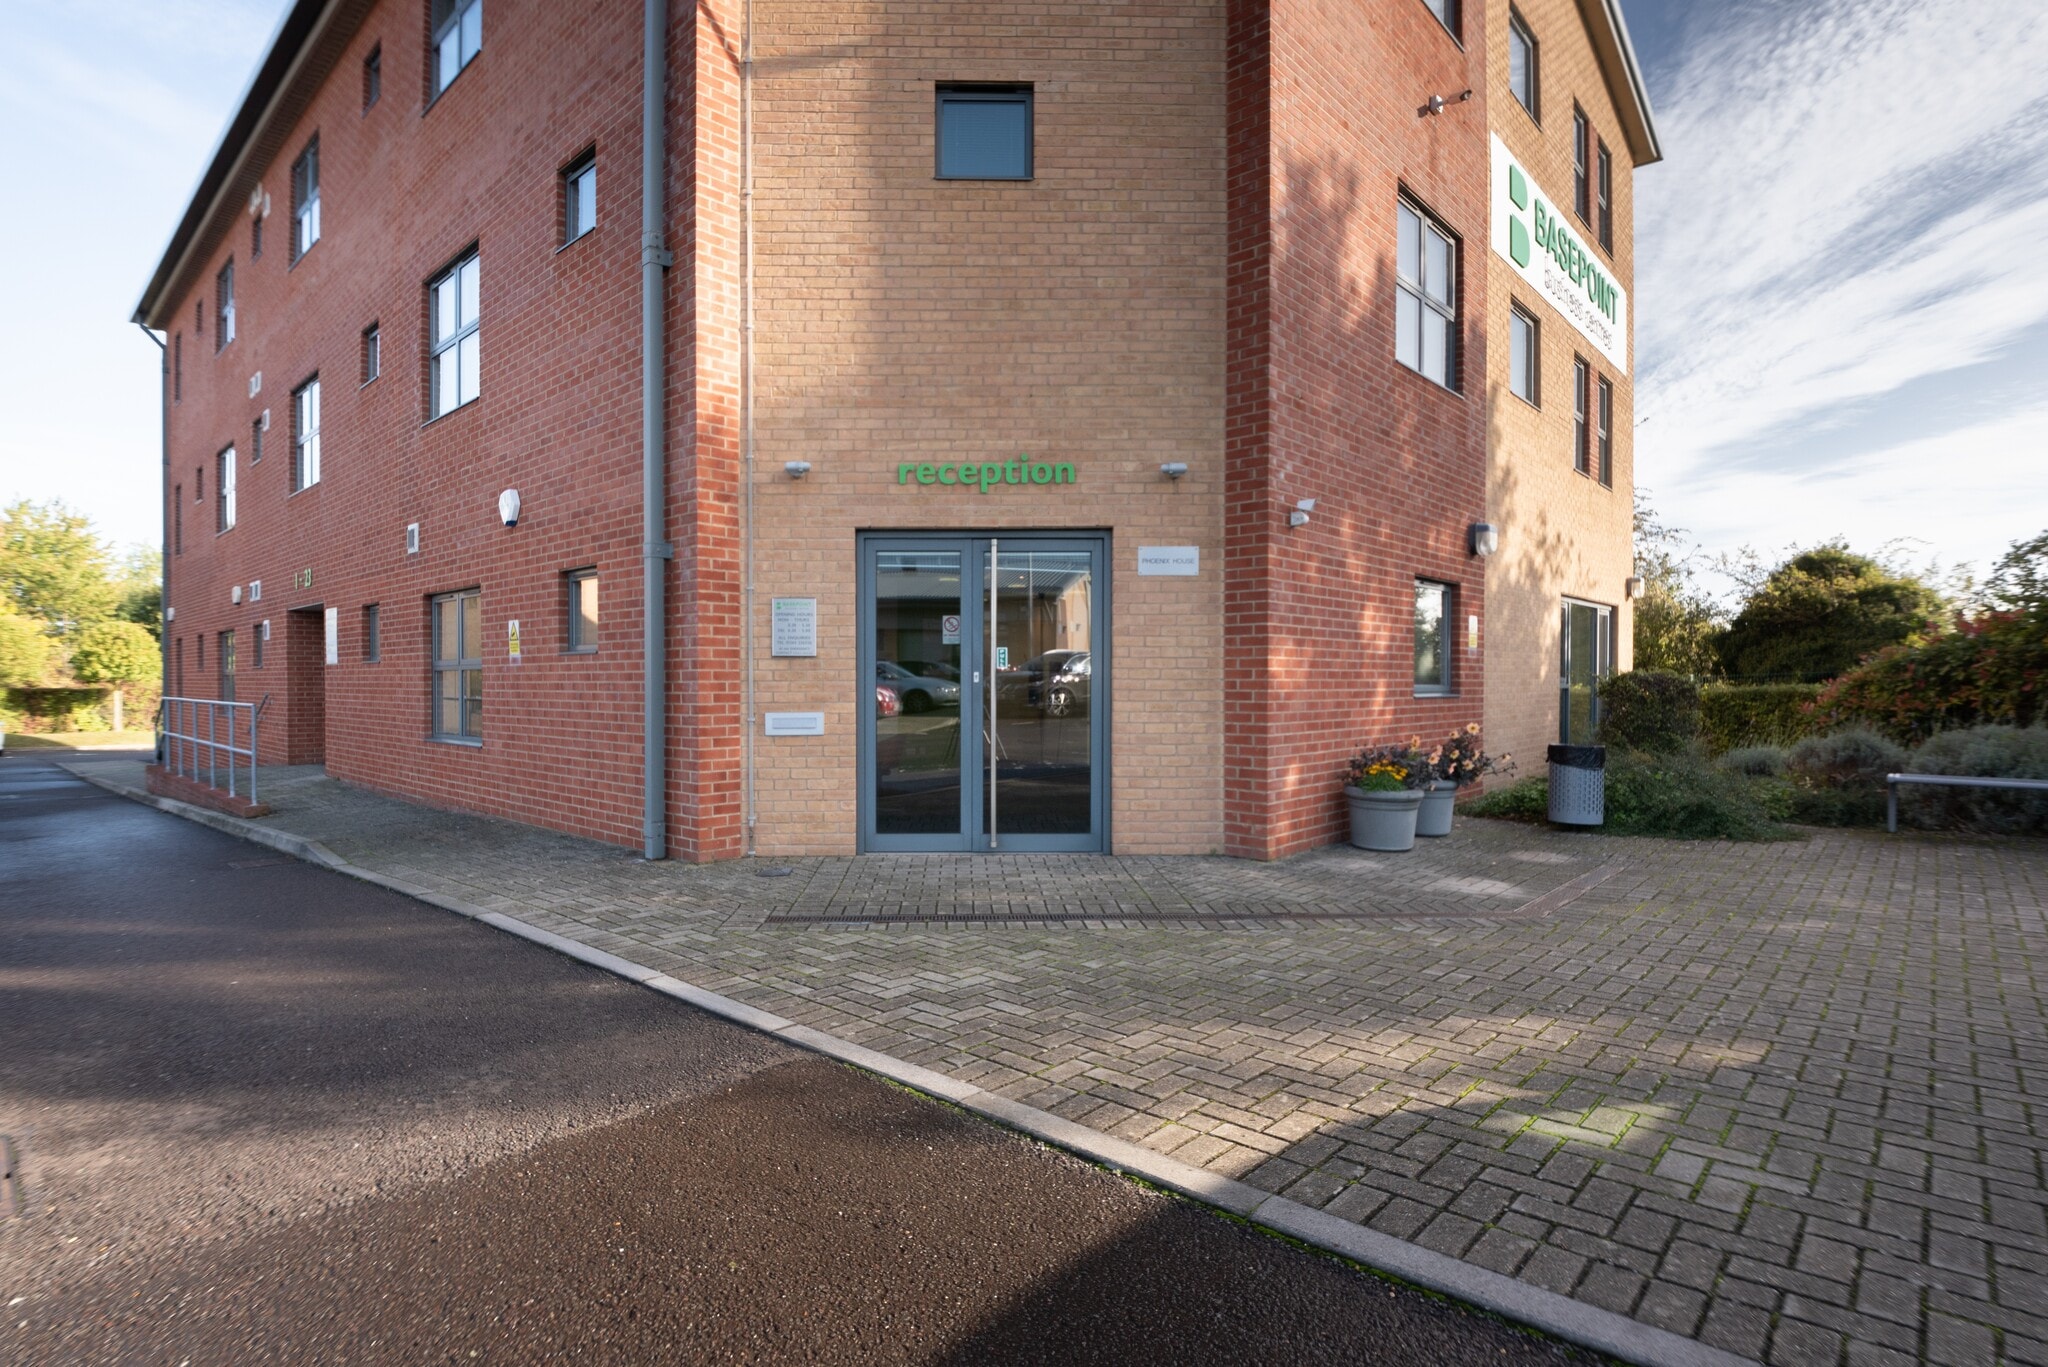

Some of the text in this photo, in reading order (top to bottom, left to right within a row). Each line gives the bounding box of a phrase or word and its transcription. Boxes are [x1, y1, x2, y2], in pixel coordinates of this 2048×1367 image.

[1534, 197, 1620, 325] BASEPOINT
[1544, 255, 1583, 321] business
[898, 453, 1076, 494] reception
[1141, 557, 1195, 565] PHOENIX HOUSE
